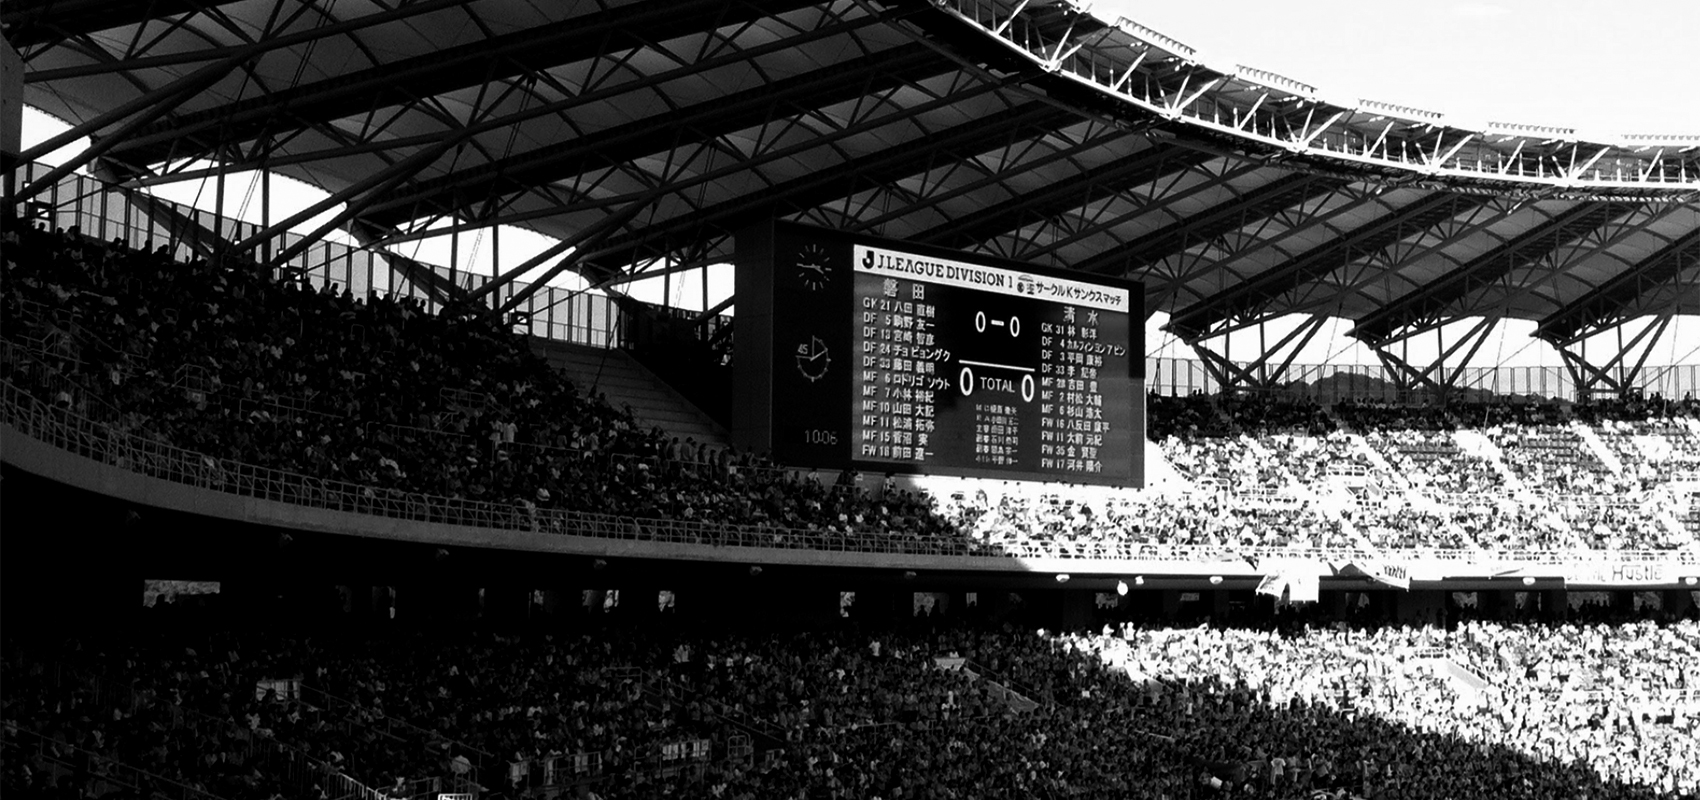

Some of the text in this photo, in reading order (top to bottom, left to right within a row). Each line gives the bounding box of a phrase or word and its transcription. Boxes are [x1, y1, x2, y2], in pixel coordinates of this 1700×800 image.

[946, 266, 1004, 287] DIVISION
[1009, 275, 1012, 288] 1
[863, 297, 877, 308] GK
[880, 299, 890, 311] 21
[894, 301, 912, 314] 八田
[863, 312, 877, 323] DF
[885, 314, 891, 325] 5
[863, 326, 876, 338] DF
[1042, 322, 1052, 333] GK
[1056, 325, 1064, 335] 31
[1068, 325, 1075, 337] 林
[1042, 336, 1052, 346] DF
[863, 341, 876, 352] DF
[880, 343, 890, 354] 24
[1042, 350, 1052, 359] DF
[863, 356, 876, 367] DF
[1042, 363, 1052, 373] DF
[863, 371, 877, 381] MF
[1042, 377, 1053, 386] MF
[960, 367, 1035, 402] 0 TOTAL 0
[863, 385, 877, 396] MF
[885, 387, 890, 398] 7
[893, 388, 912, 401] 小林
[1042, 390, 1053, 400] MF
[1059, 392, 1064, 402] 2
[863, 400, 877, 411] MF
[880, 402, 889, 412] 10
[893, 402, 911, 415] 山田
[1042, 404, 1053, 413] MF
[1059, 405, 1064, 415] 6
[863, 415, 877, 425] MF
[881, 416, 889, 427] 11
[1042, 417, 1054, 427] FW
[863, 430, 877, 440] MF
[881, 431, 890, 442] 15
[1042, 431, 1053, 441] FW
[1057, 432, 1063, 442] 11
[863, 444, 876, 455] FW
[1042, 444, 1053, 454] FW
[1056, 445, 1065, 456] 35
[1067, 445, 1075, 457] 金
[1042, 458, 1053, 468] FW
[1057, 459, 1065, 469] 17
